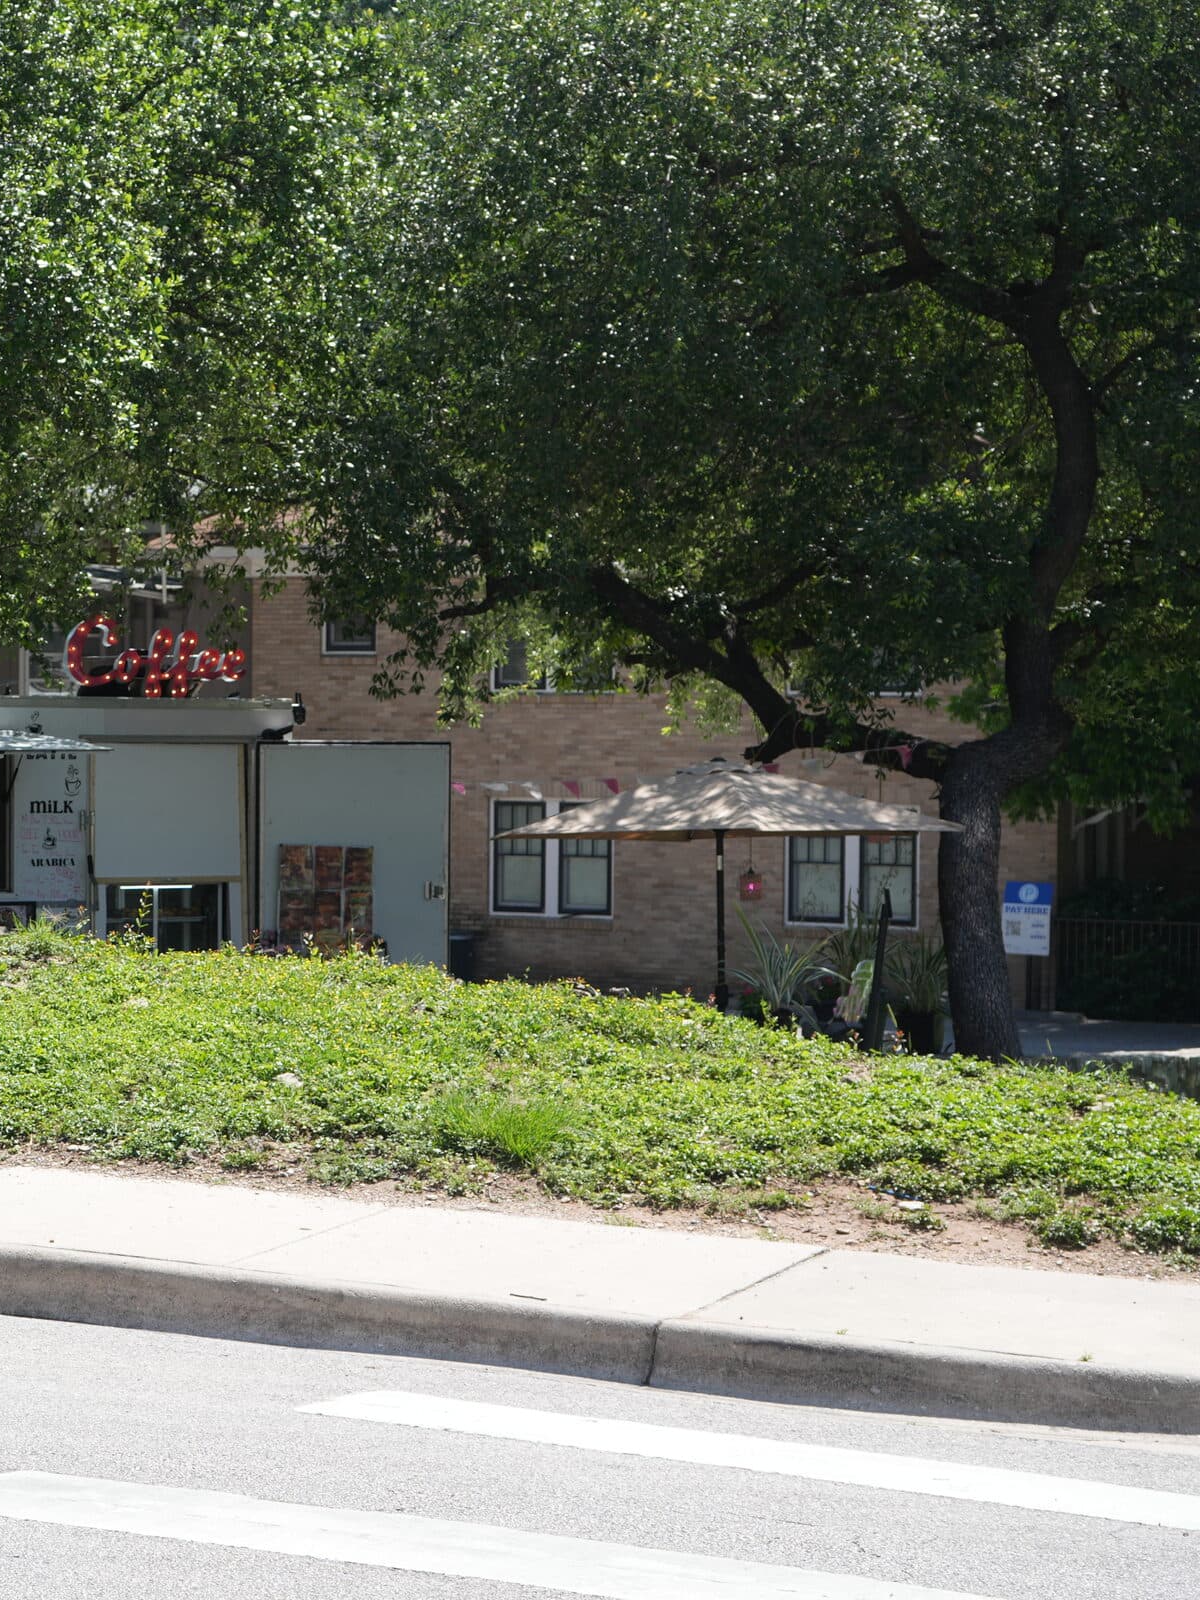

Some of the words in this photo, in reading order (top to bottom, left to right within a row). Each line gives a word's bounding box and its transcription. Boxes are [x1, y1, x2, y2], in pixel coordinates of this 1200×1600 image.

[63, 615, 247, 698] Coffee
[30, 857, 76, 867] ARABICA
[1005, 905, 1021, 913] PAY
[1024, 906, 1049, 914] HERE
